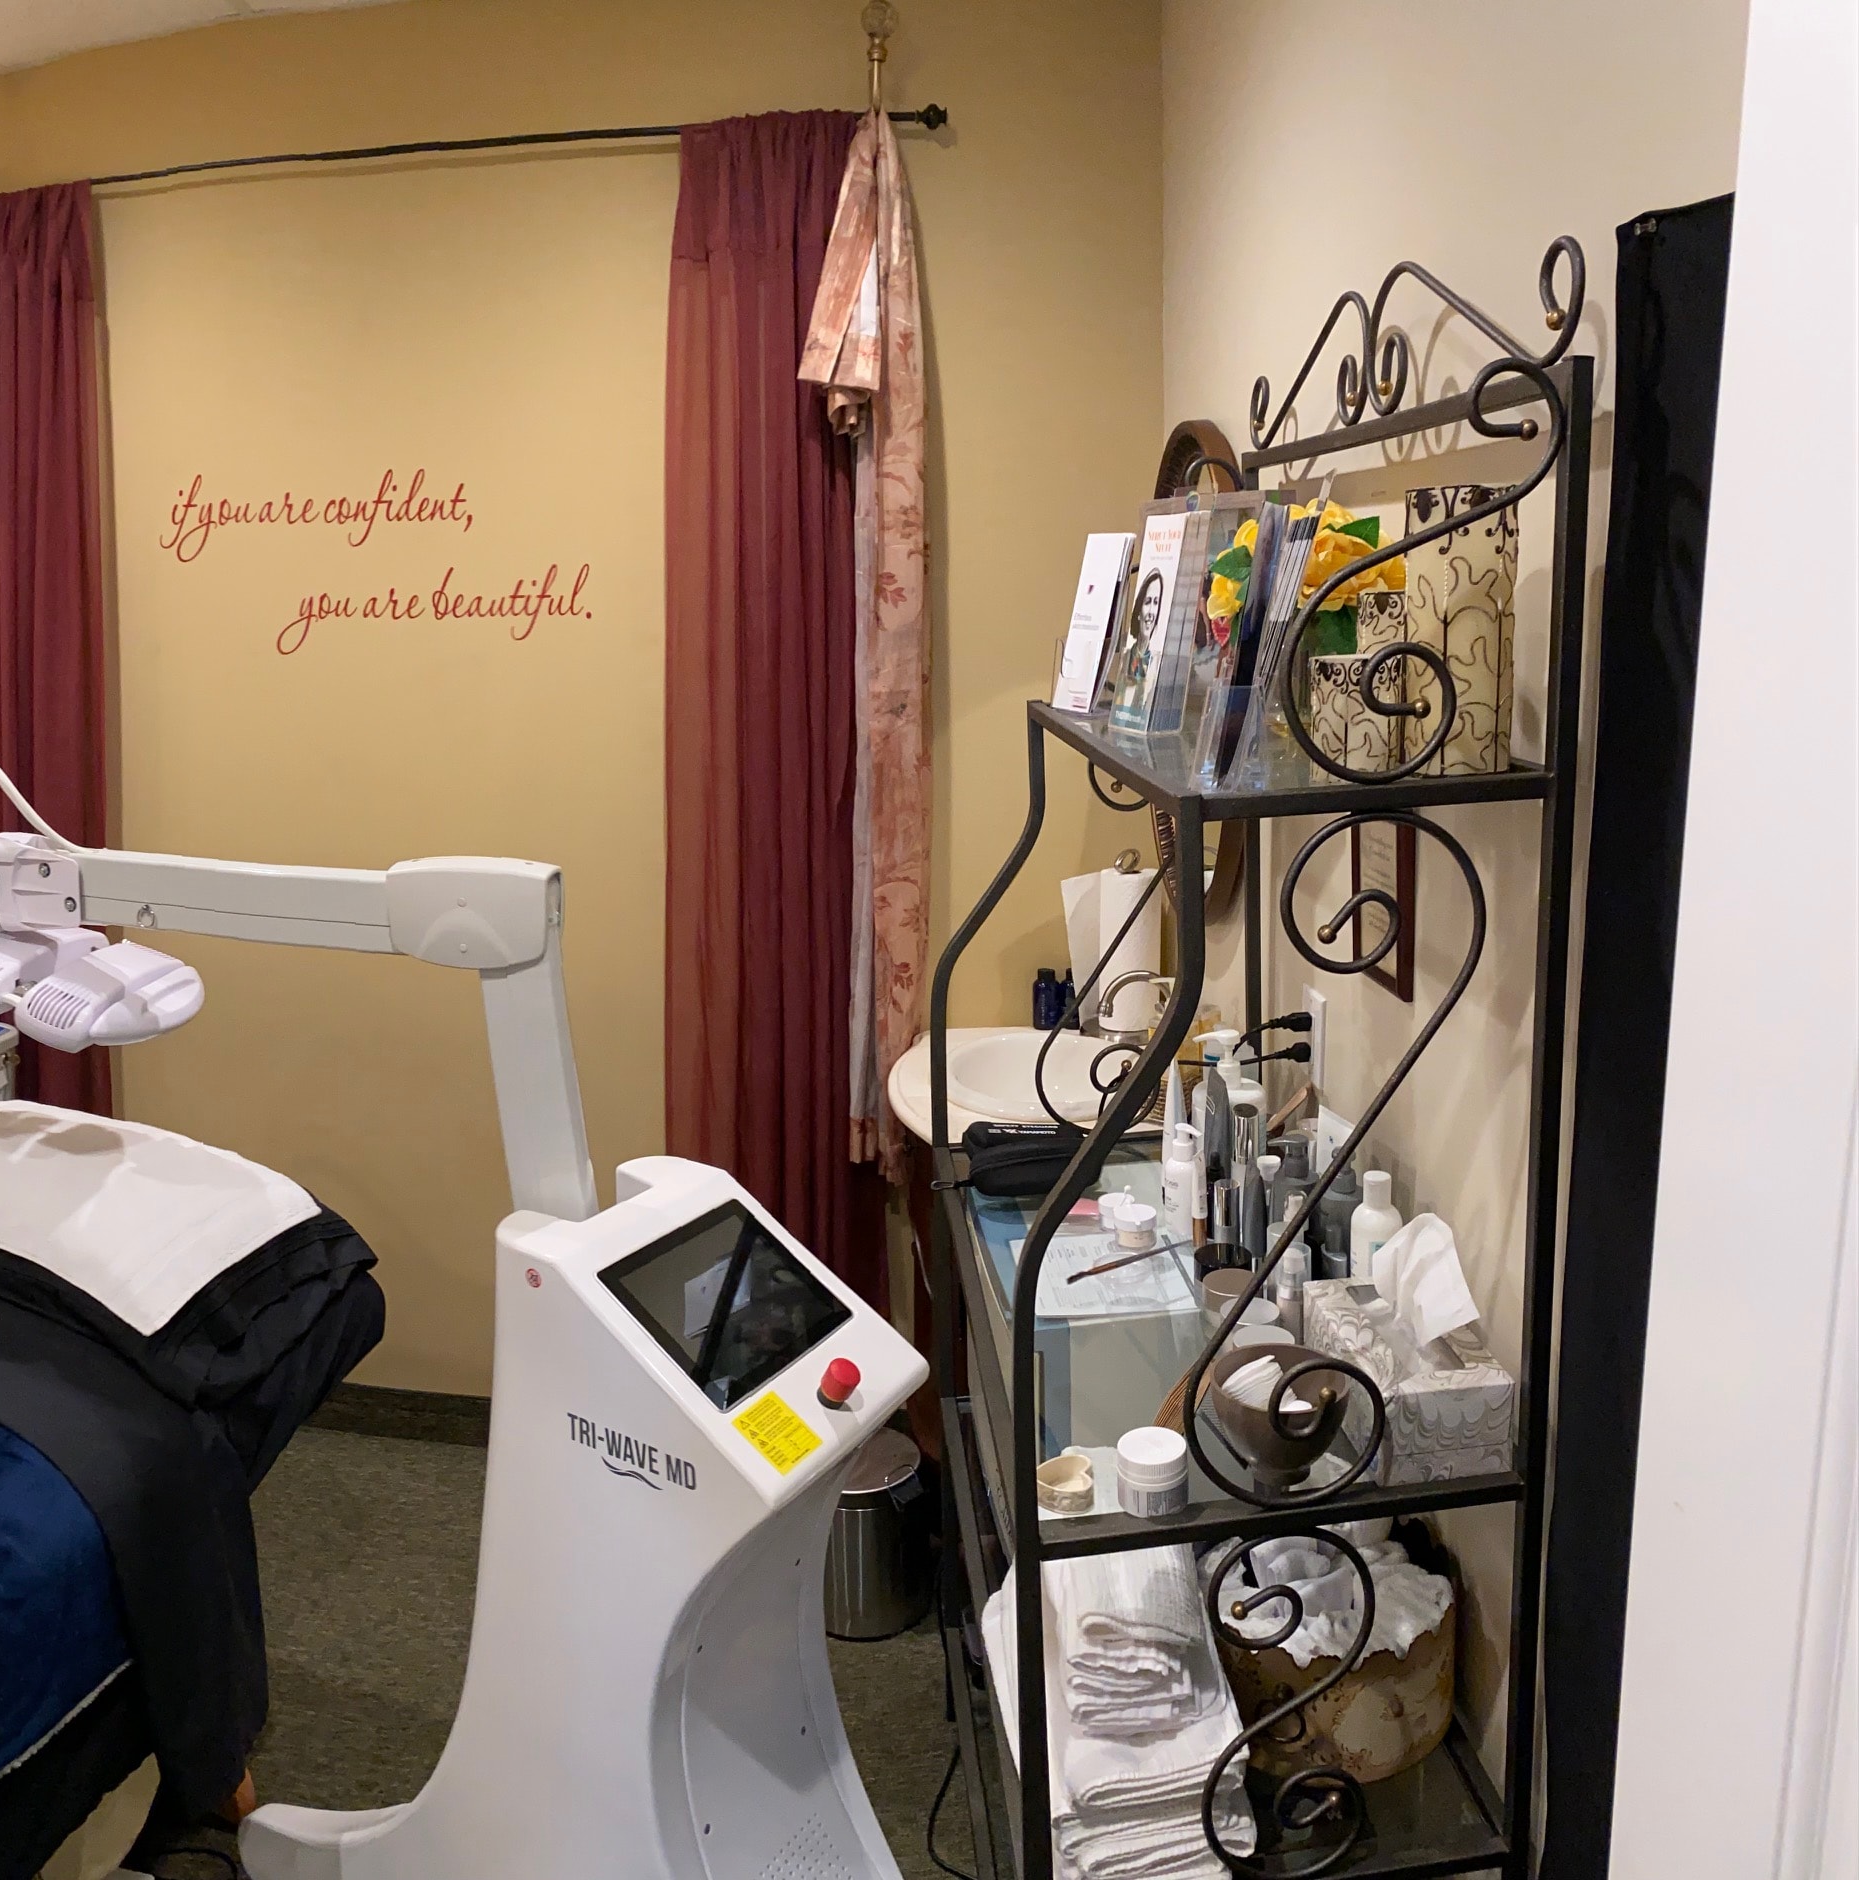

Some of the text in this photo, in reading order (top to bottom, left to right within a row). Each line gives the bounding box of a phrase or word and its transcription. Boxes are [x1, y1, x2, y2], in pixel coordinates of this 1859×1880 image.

[160, 469, 474, 563] if you are confident,
[276, 563, 593, 656] you are beautiful.
[567, 1412, 697, 1491] TRI-WAVE MD
